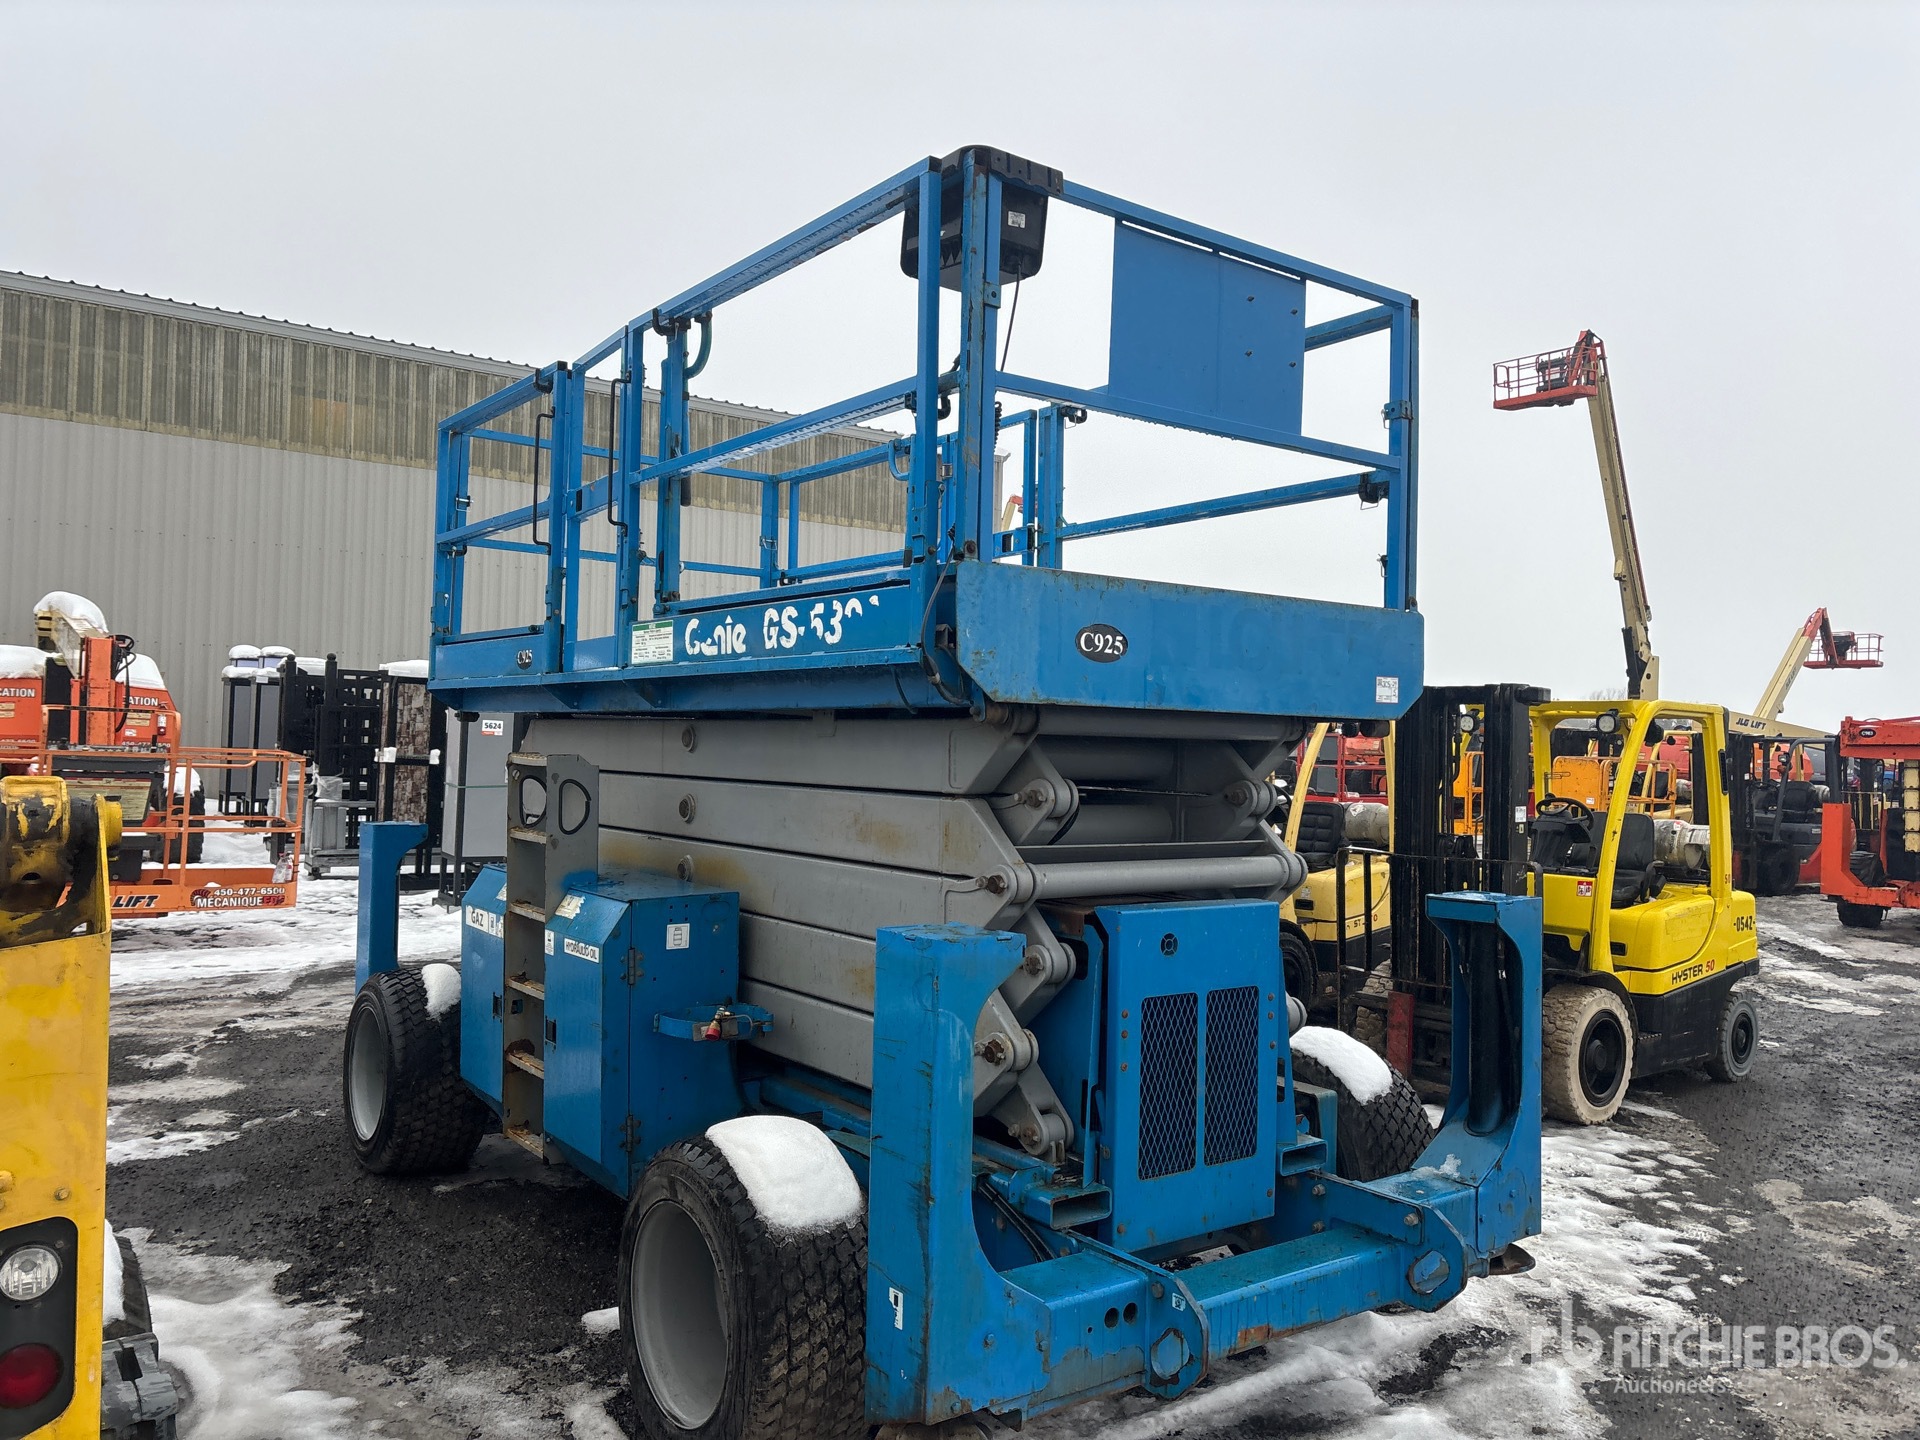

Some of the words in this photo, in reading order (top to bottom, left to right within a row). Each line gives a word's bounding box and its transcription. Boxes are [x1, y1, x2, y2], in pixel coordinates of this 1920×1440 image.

[1080, 631, 1124, 655] C925
[122, 695, 159, 707] ATION
[484, 722, 502, 730] 5624
[1750, 720, 1767, 731] LIFT
[111, 894, 161, 909] LIFT
[470, 910, 485, 928] GAZ
[1671, 963, 1704, 985] HYSTER
[1705, 959, 1716, 974] 50
